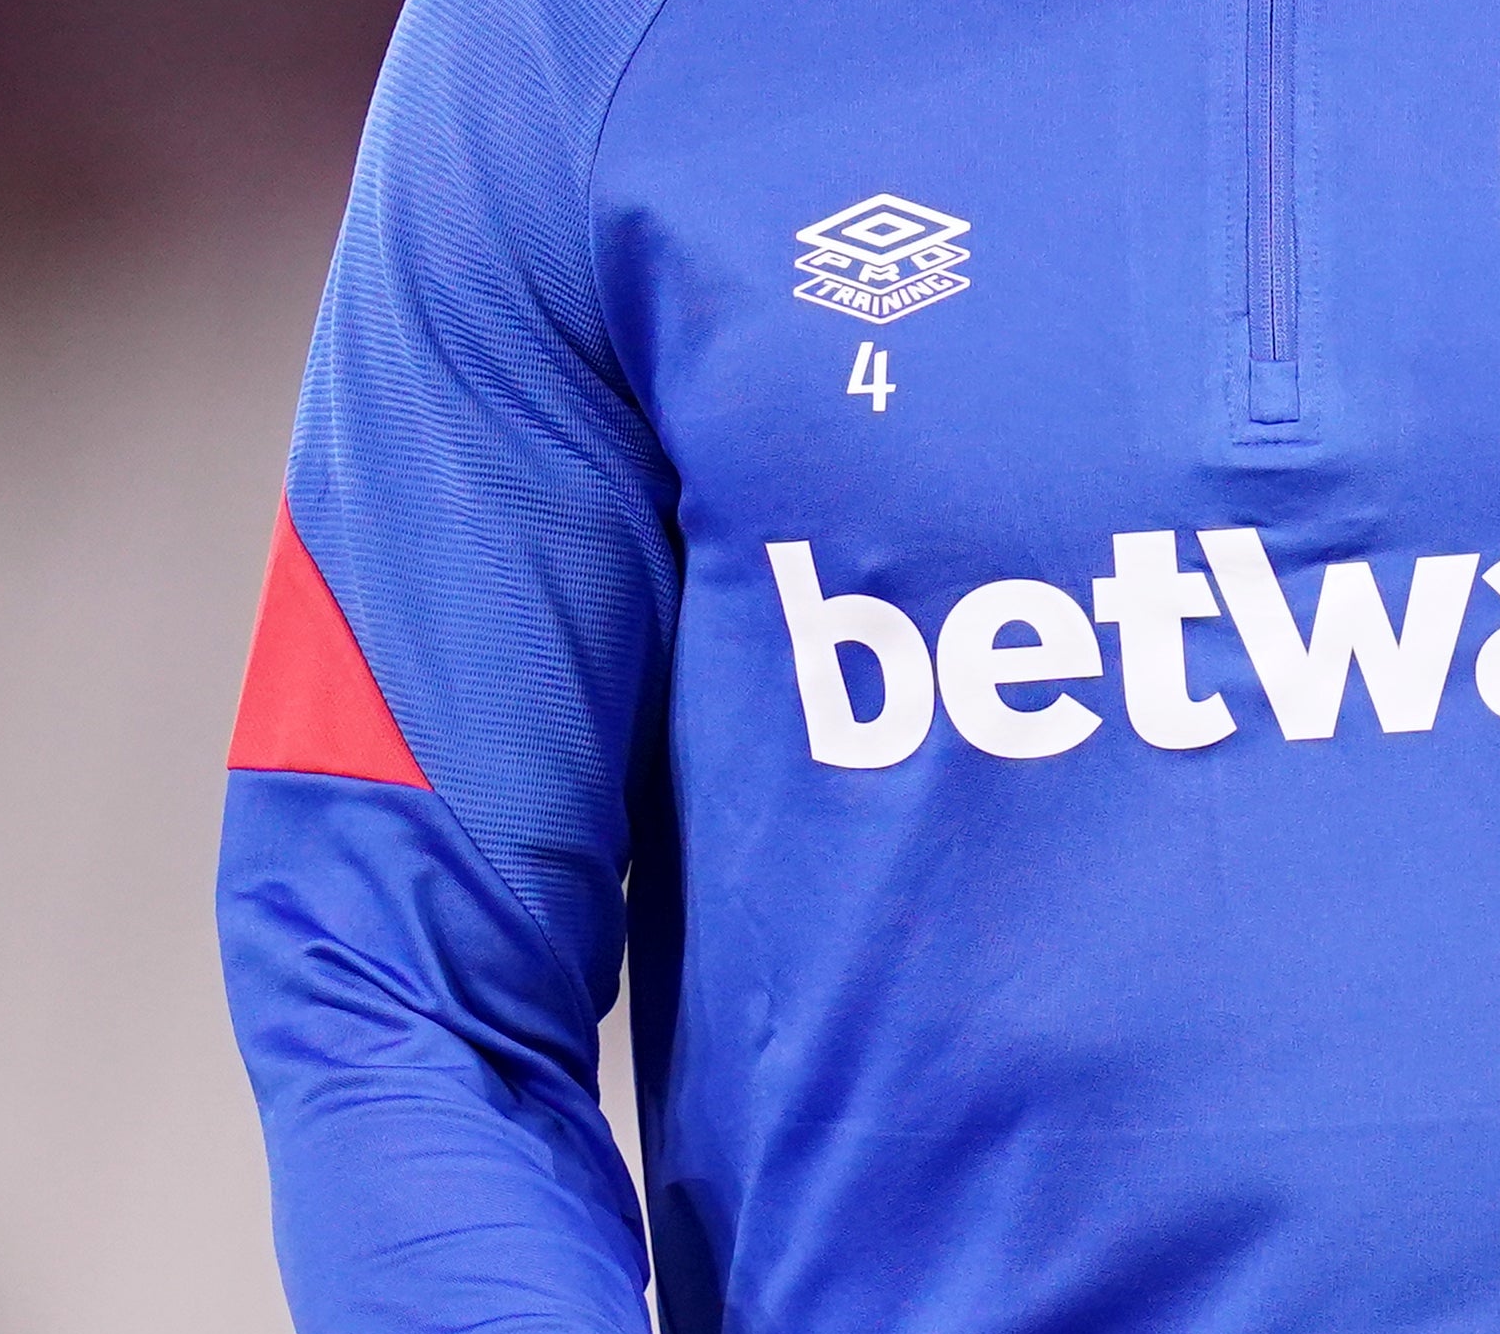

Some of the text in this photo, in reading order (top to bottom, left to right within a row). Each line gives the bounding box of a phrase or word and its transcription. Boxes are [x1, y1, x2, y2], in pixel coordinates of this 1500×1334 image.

[808, 243, 958, 283] PRO
[815, 273, 955, 316] TRAINING
[846, 340, 897, 412] 4
